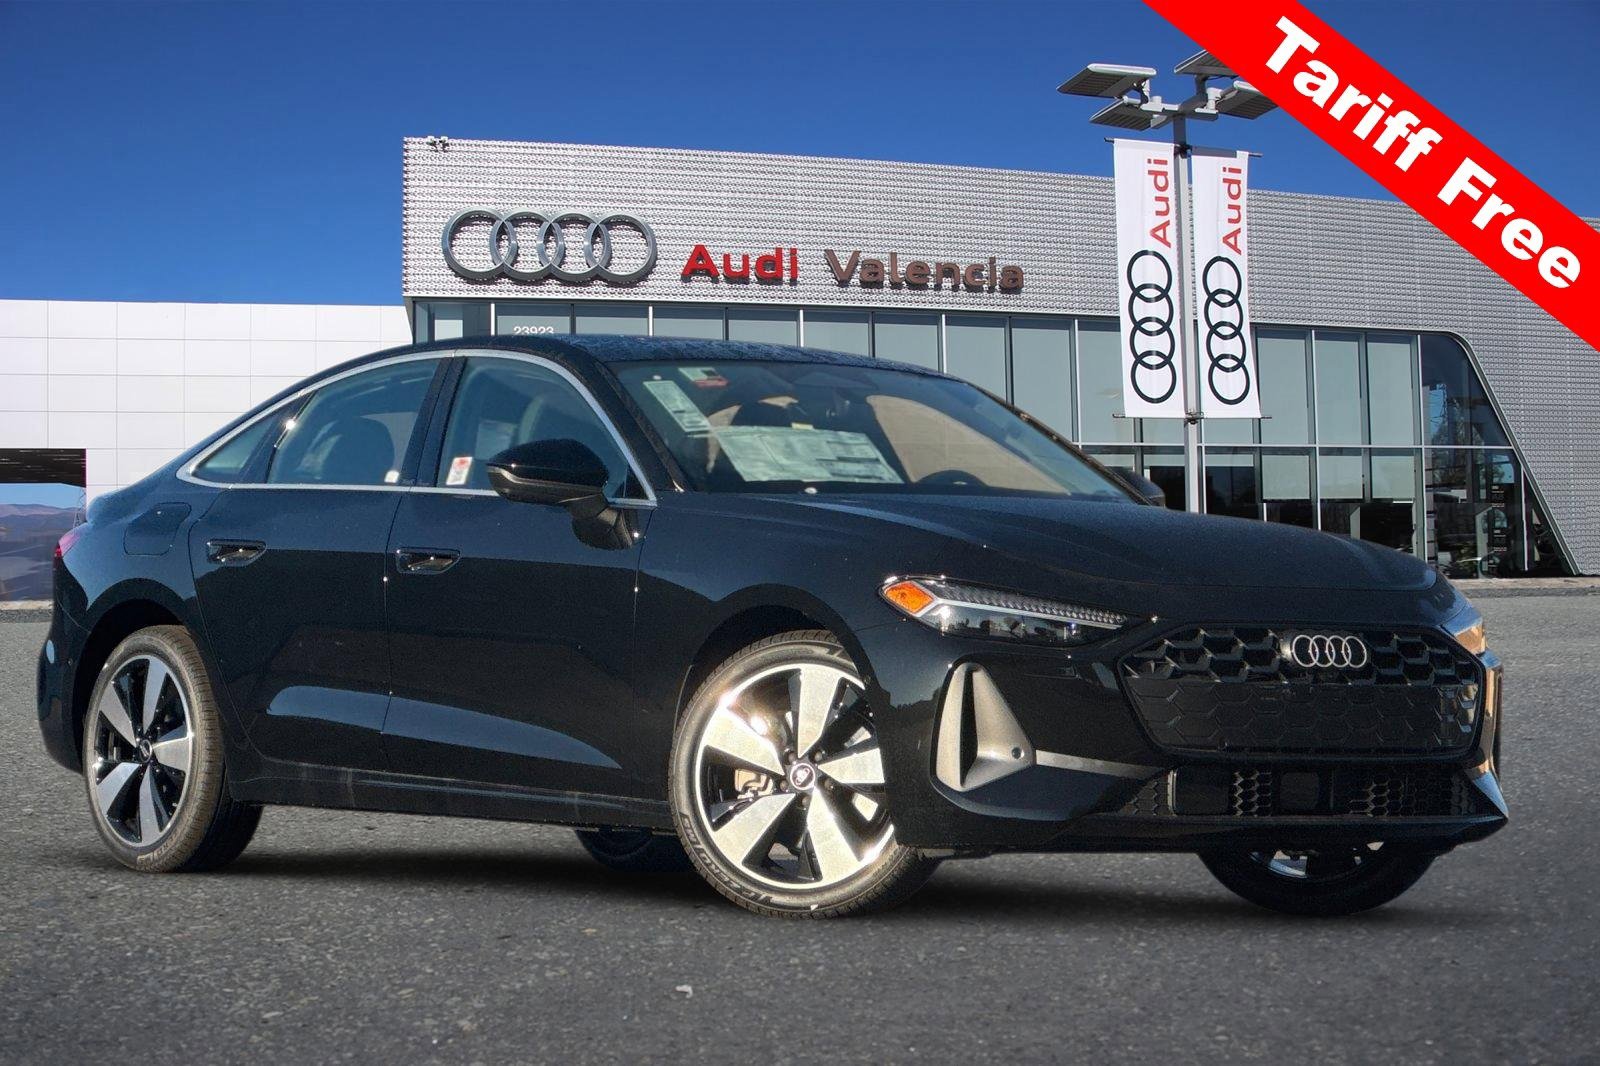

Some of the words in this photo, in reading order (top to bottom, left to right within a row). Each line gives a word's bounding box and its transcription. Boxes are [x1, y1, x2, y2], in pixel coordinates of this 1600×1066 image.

[1148, 158, 1171, 248] Audi
[1222, 166, 1242, 255] Audi
[682, 244, 800, 282] Audi
[825, 249, 1024, 290] Valencia
